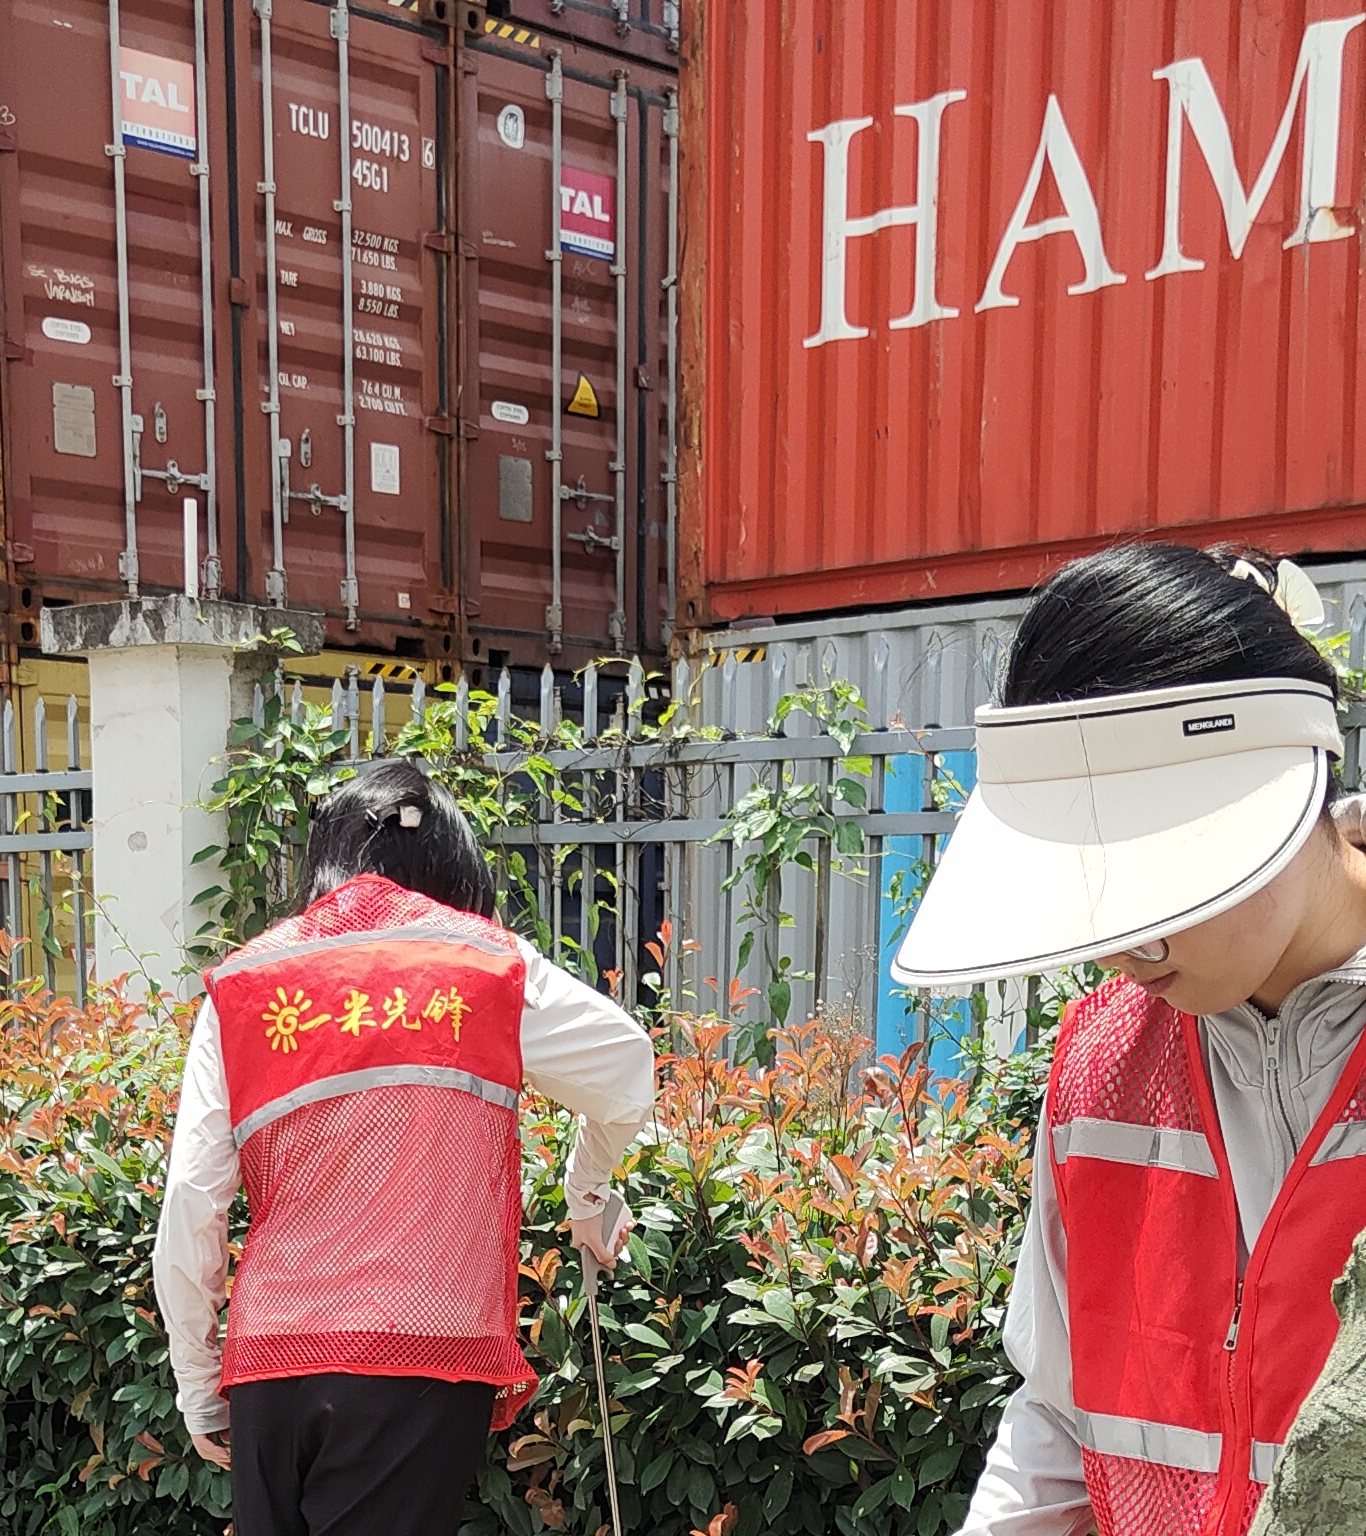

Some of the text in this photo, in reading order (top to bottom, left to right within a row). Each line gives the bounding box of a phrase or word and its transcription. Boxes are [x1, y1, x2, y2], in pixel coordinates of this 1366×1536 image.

[119, 71, 189, 112] TAL
[289, 103, 434, 167] TCLU 500413 6
[352, 158, 388, 193] 45G1
[560, 186, 610, 222] TAL
[275, 219, 400, 254] MAX. GROSS 32.500 KGS.
[351, 247, 398, 271] 71.650 LBS.
[280, 269, 403, 302] TARE 3.880 KGS.
[358, 297, 382, 315] 8.550
[279, 320, 295, 337] NET
[352, 329, 383, 346] 28.620
[356, 345, 403, 367] 63.100 LBS.
[361, 379, 380, 397] 76.4
